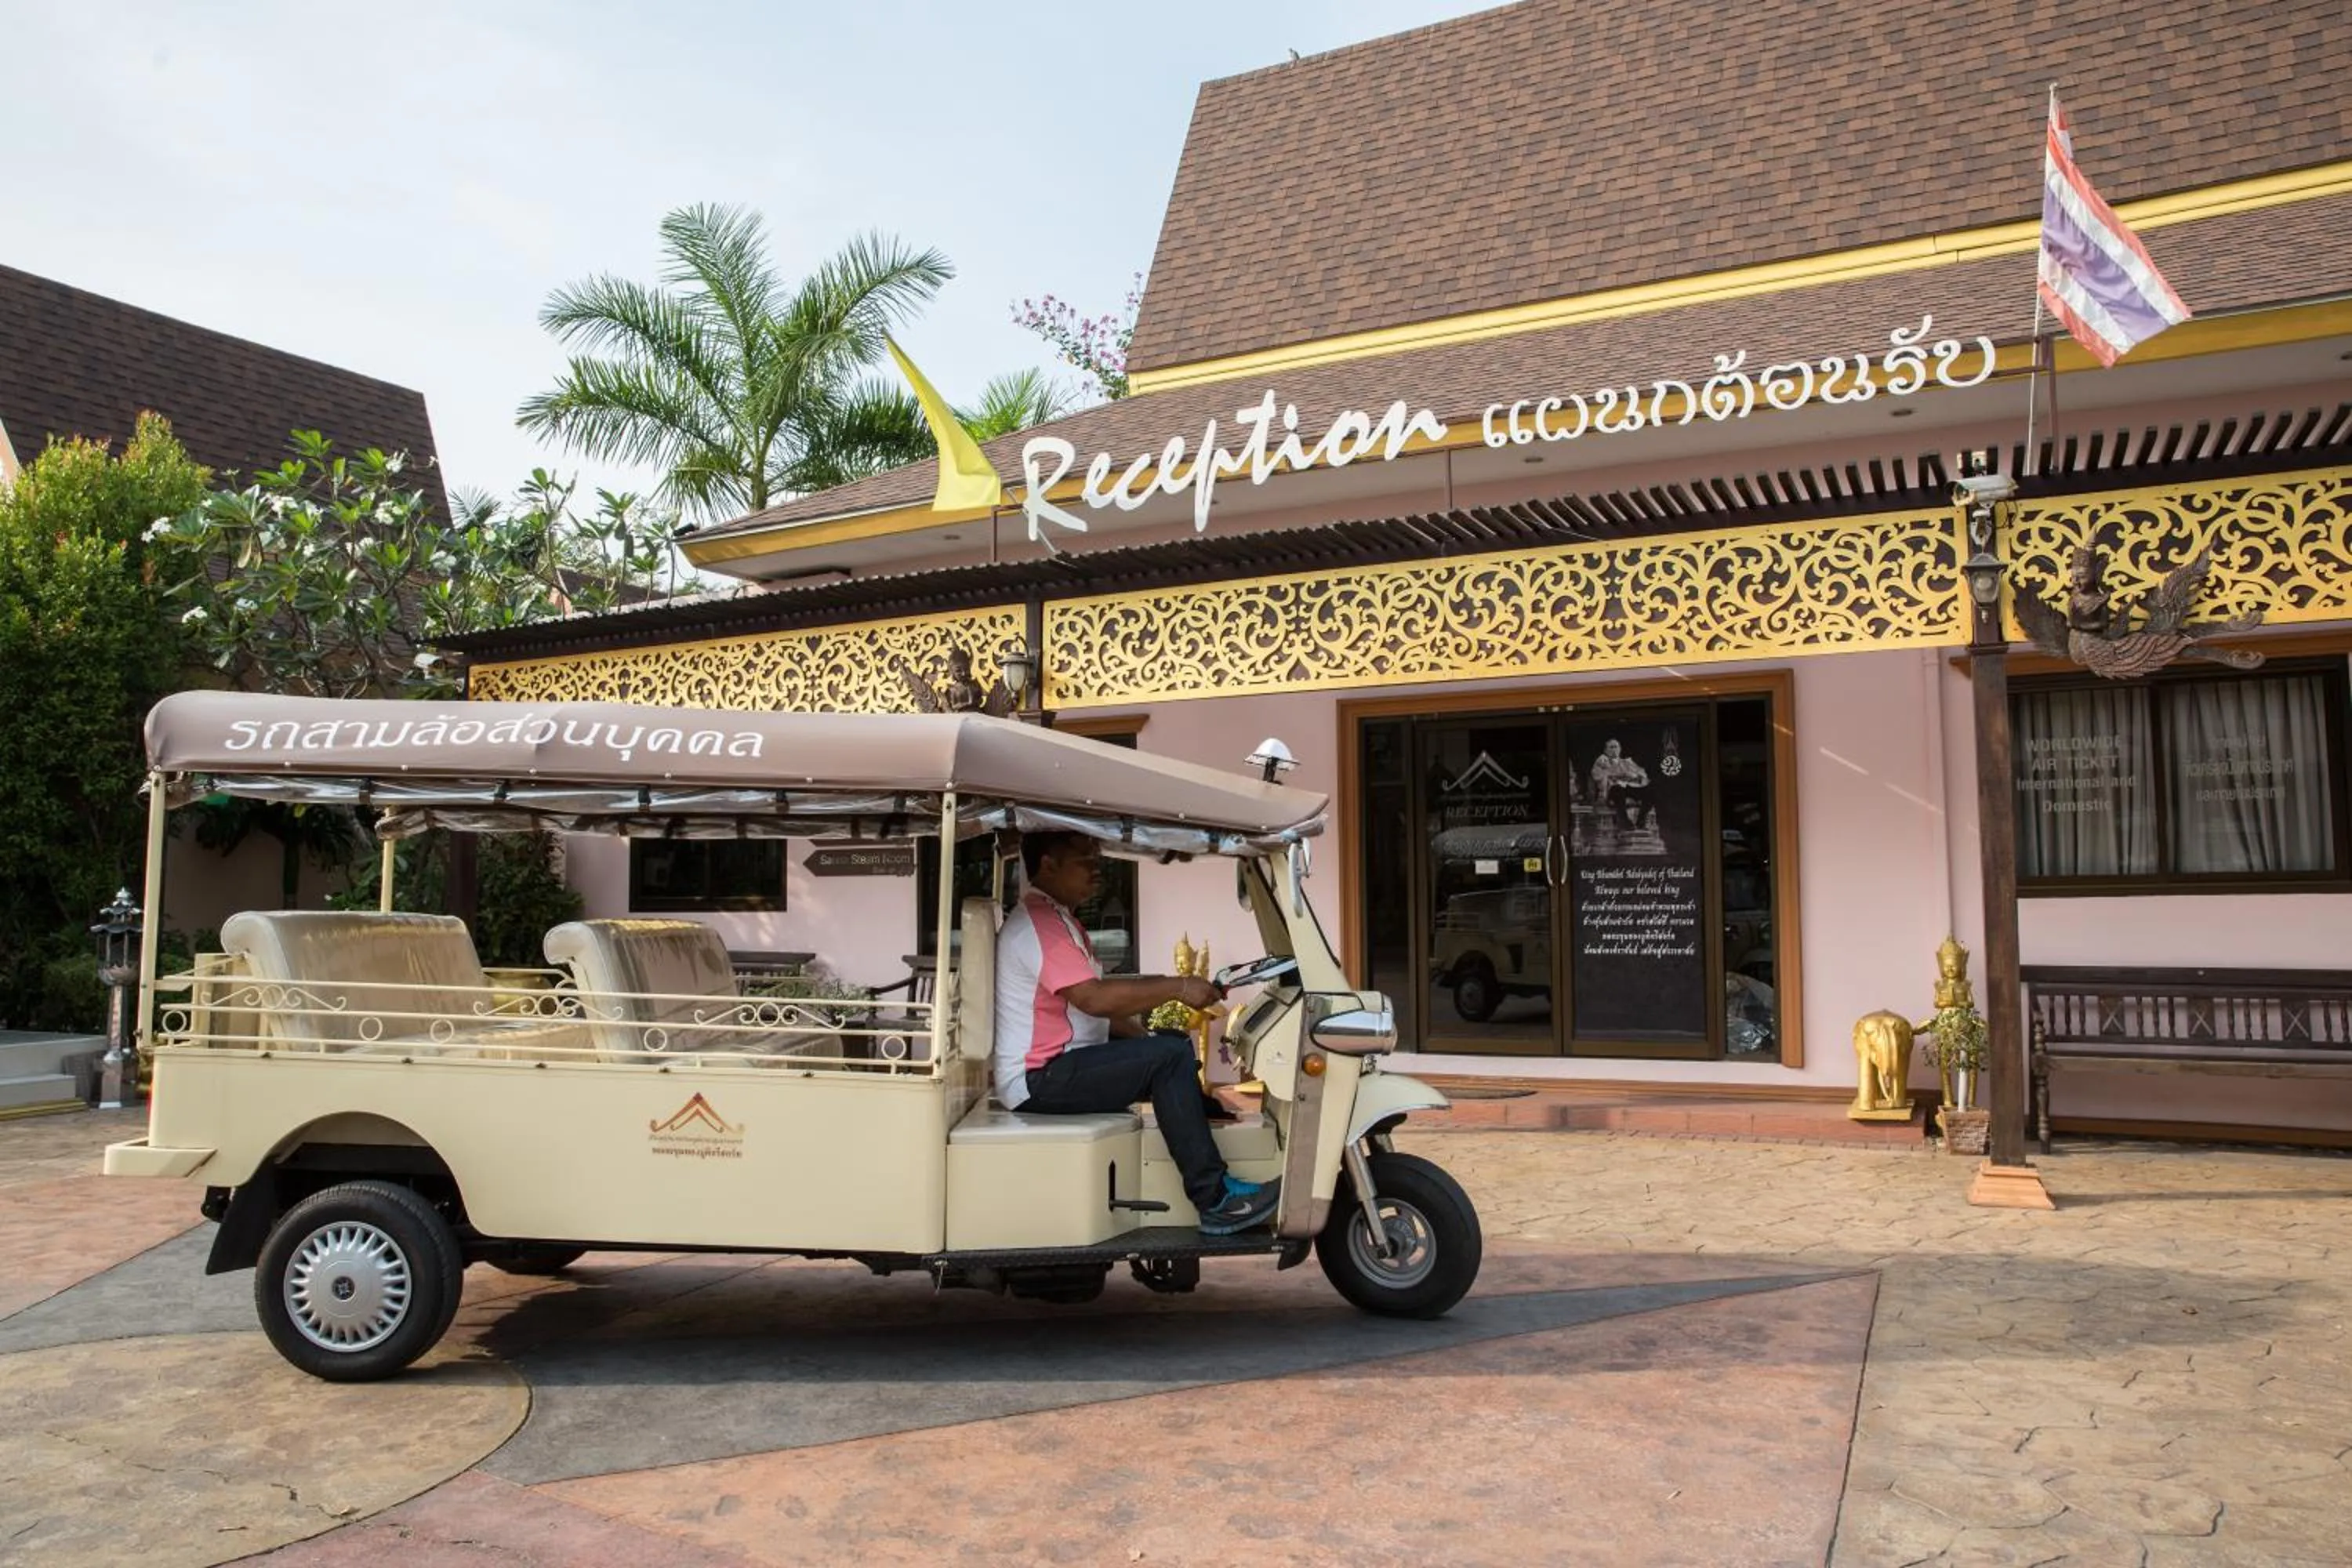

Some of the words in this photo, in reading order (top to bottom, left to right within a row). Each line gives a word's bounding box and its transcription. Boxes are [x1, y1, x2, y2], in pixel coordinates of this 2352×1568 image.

[1482, 314, 1996, 448] แผนกต้อนรับ
[1022, 389, 1448, 542] Reception
[225, 712, 764, 761] รถสามล้อส่วนบุคคล
[2025, 734, 2122, 752] WORLDWIDE
[2032, 757, 2058, 771] AIR
[2067, 754, 2119, 769] TICKET
[2016, 775, 2105, 791] International
[2111, 775, 2137, 788] and
[2042, 798, 2113, 813] Domestic
